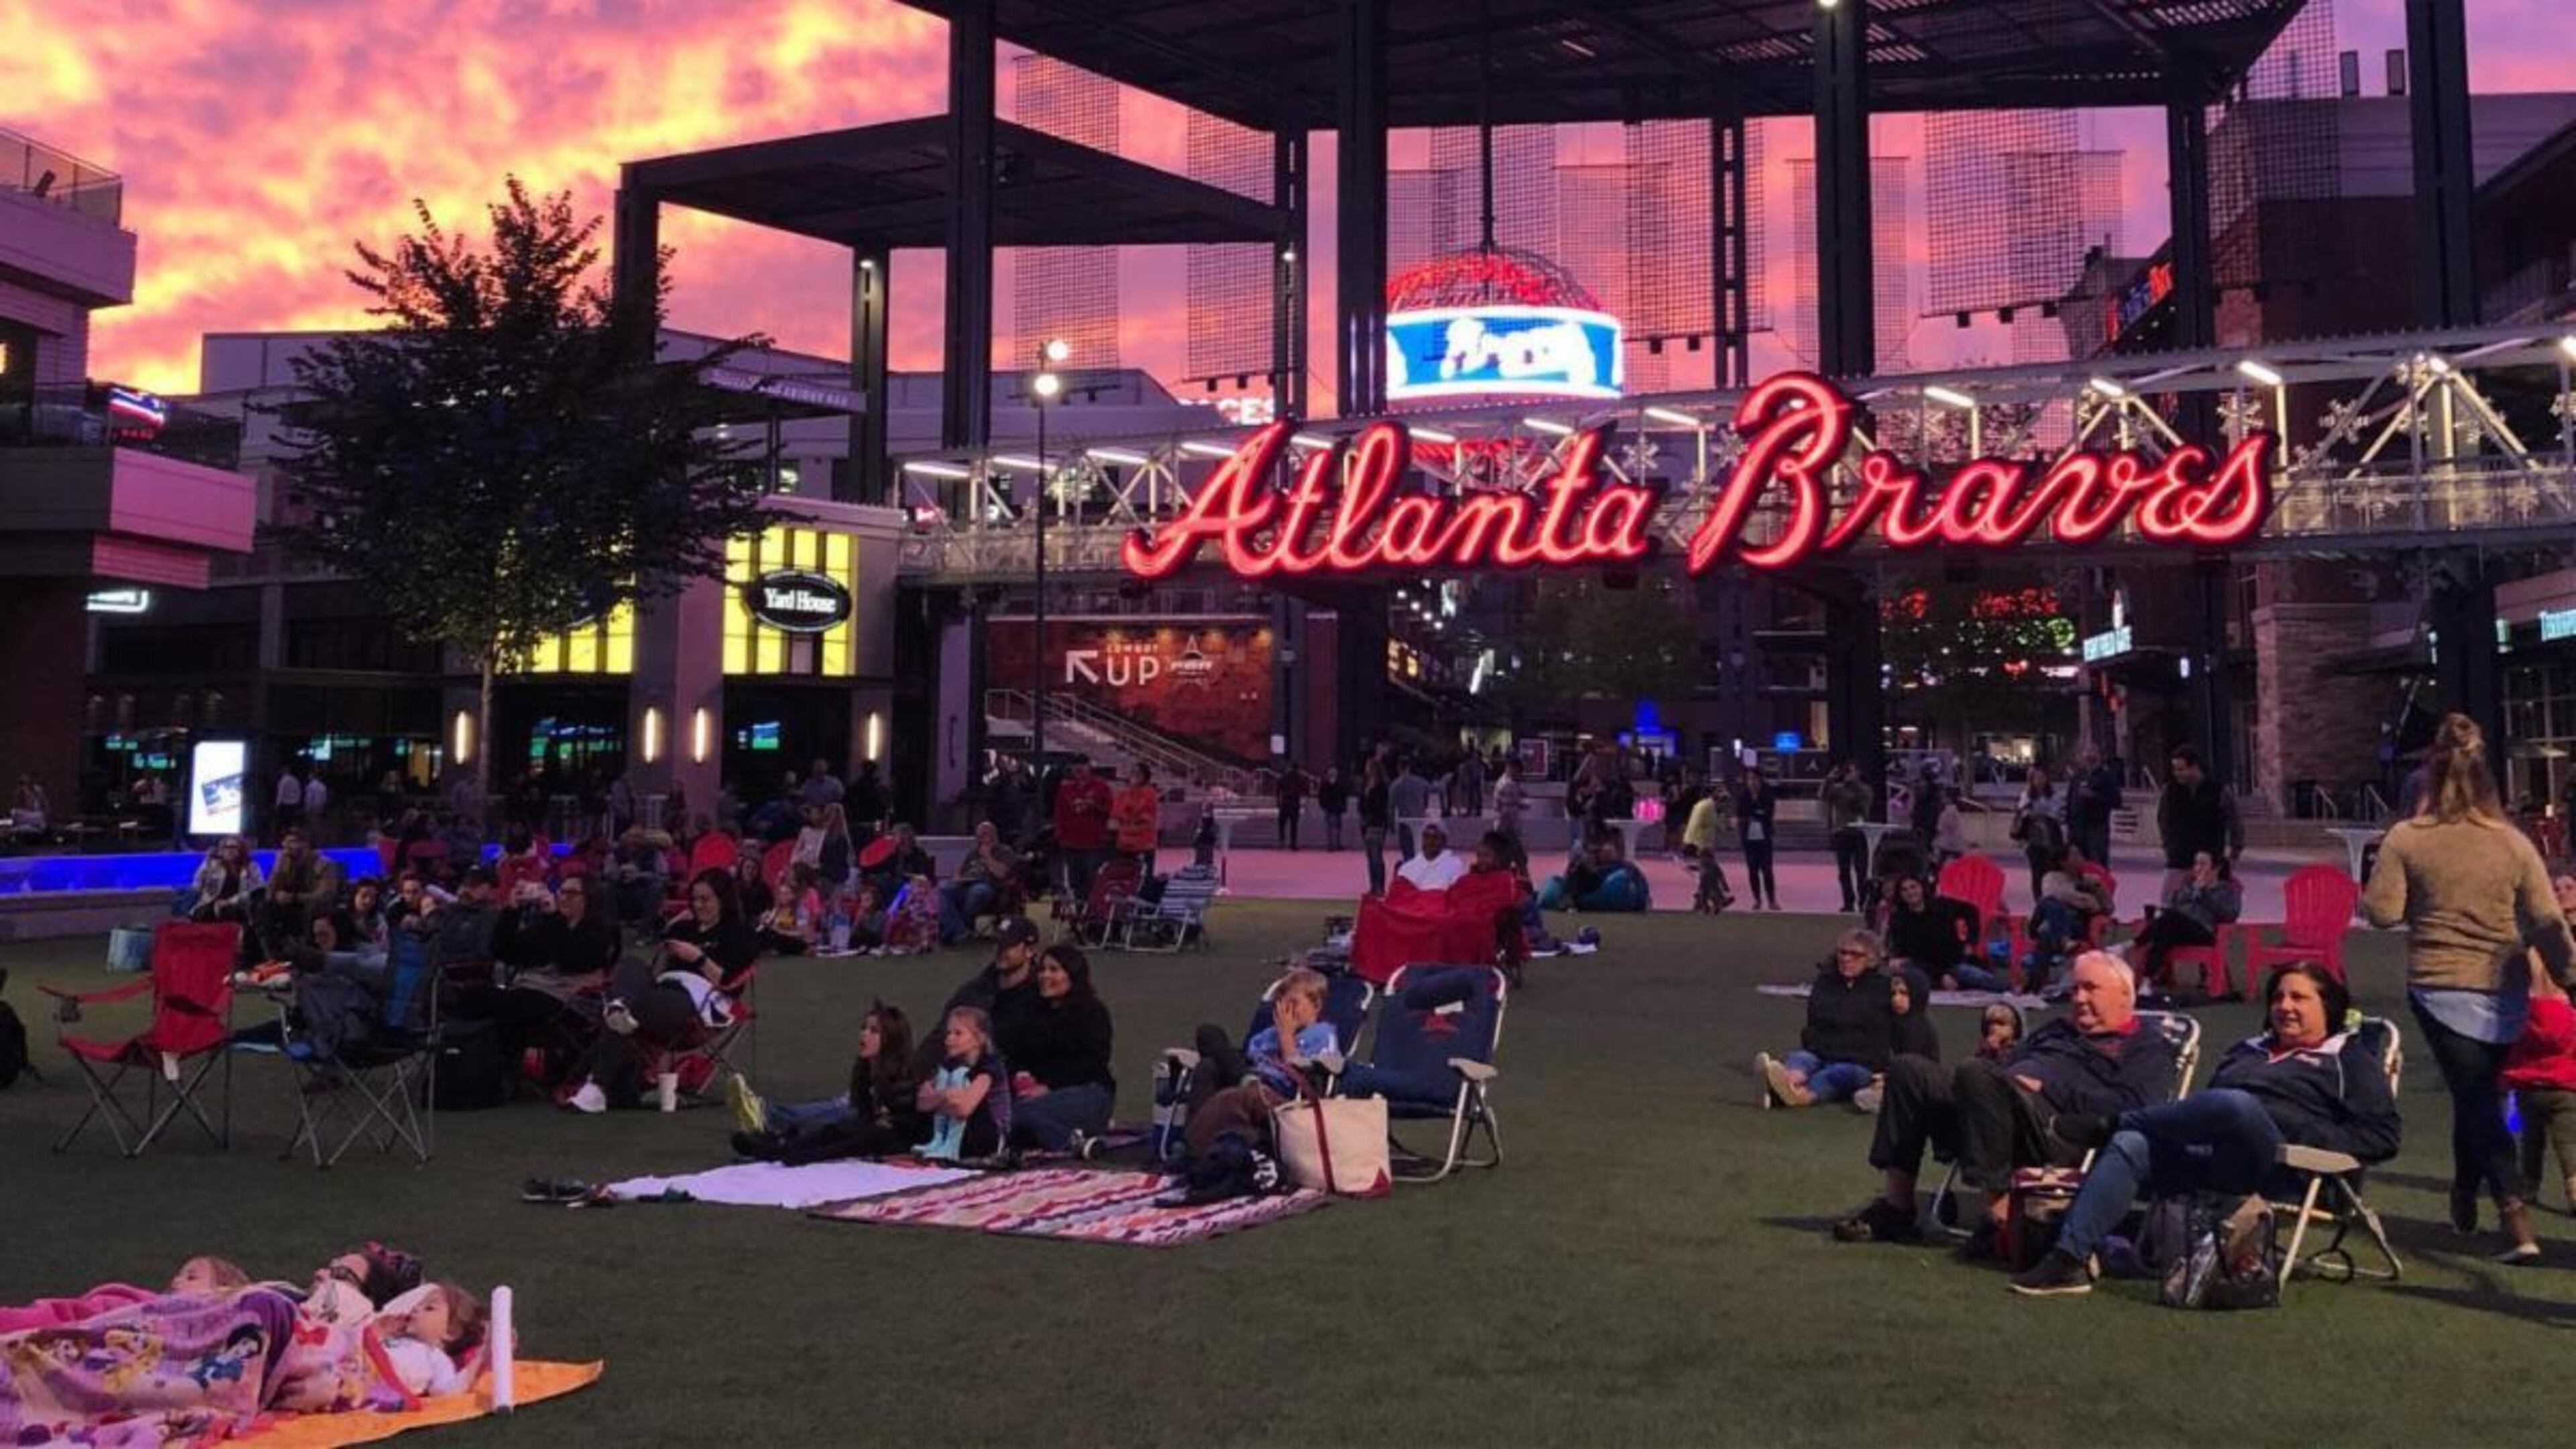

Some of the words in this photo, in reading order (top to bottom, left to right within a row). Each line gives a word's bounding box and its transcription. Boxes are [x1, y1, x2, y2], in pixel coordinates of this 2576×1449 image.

[1124, 421, 1654, 578] Atlanta
[1688, 372, 2277, 575] Braves
[763, 587, 795, 610] Yard
[796, 589, 837, 613] House
[1106, 655, 1161, 686] UP
